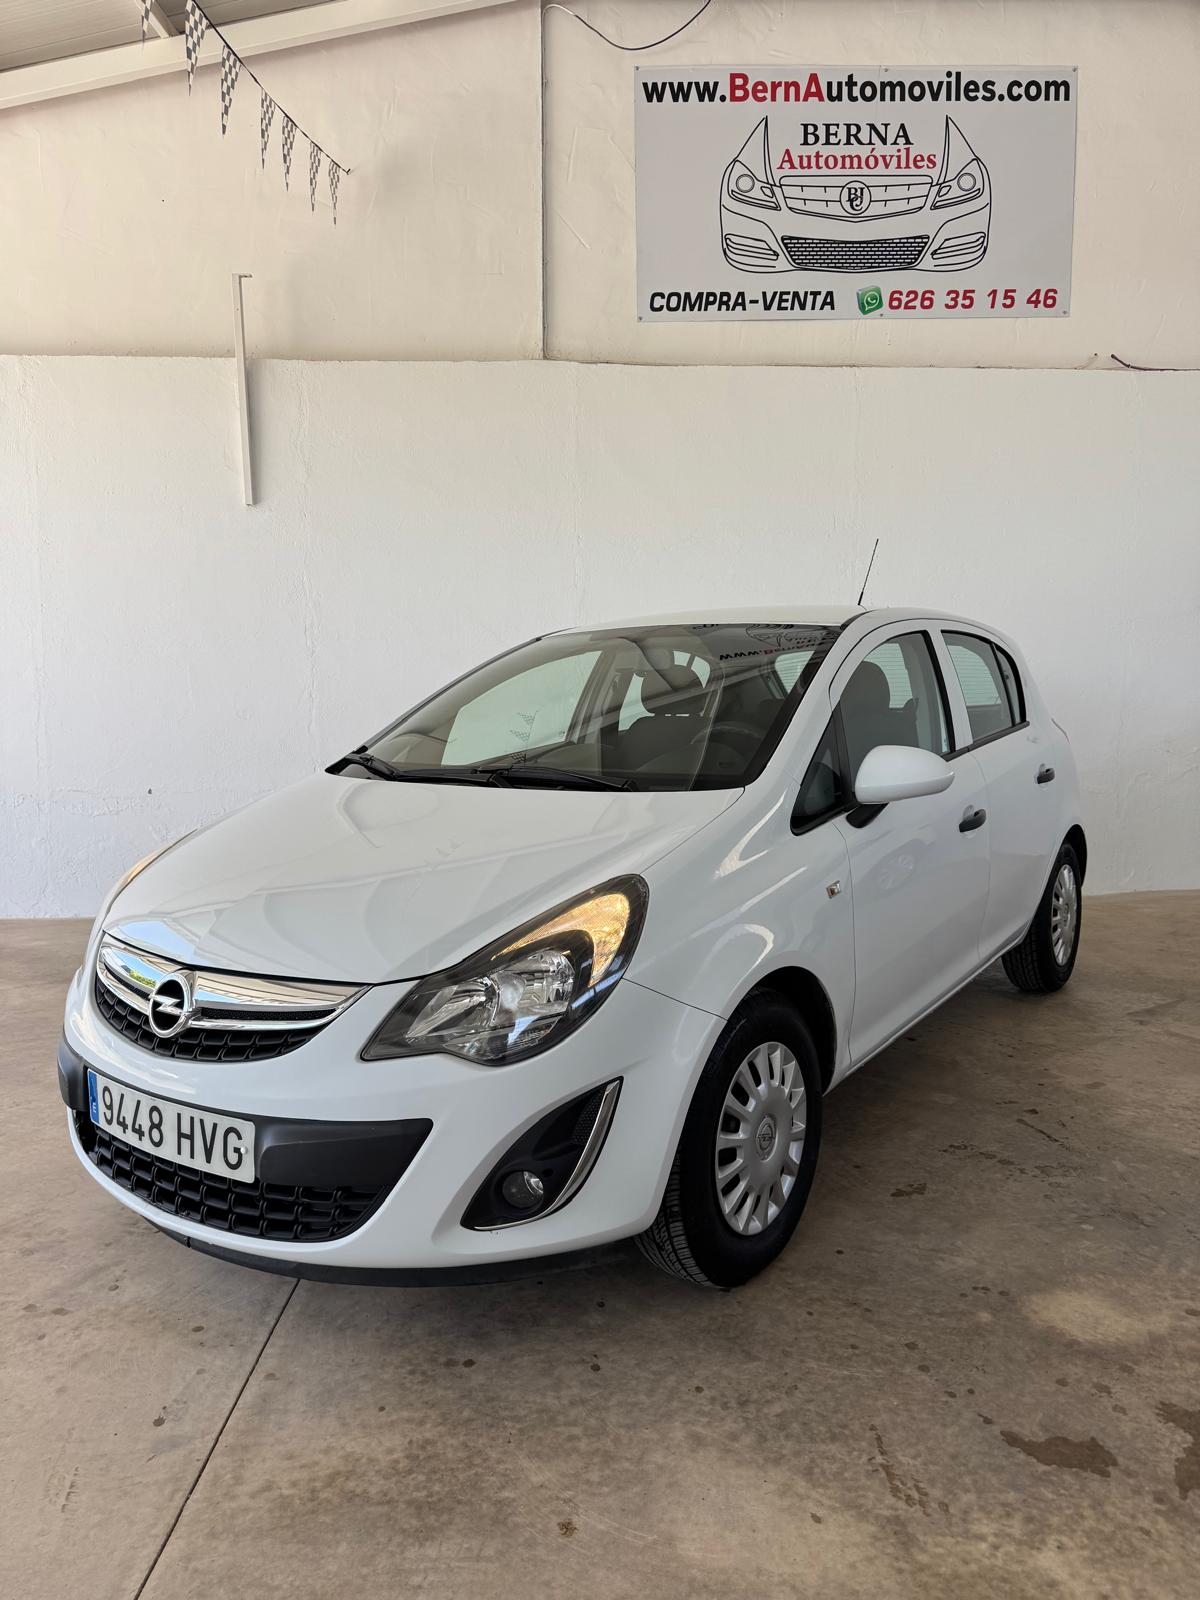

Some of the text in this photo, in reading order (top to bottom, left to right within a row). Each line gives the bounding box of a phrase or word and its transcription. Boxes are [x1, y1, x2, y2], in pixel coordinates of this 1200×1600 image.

[642, 71, 1070, 102] www.BernAutomoviles.com
[800, 123, 914, 146] BERNA
[777, 147, 937, 170] Automóviles
[650, 291, 835, 312] COMPRA-VENTA
[888, 289, 1058, 310] 626 35 15 46
[103, 1086, 243, 1170] 9448 HVG
